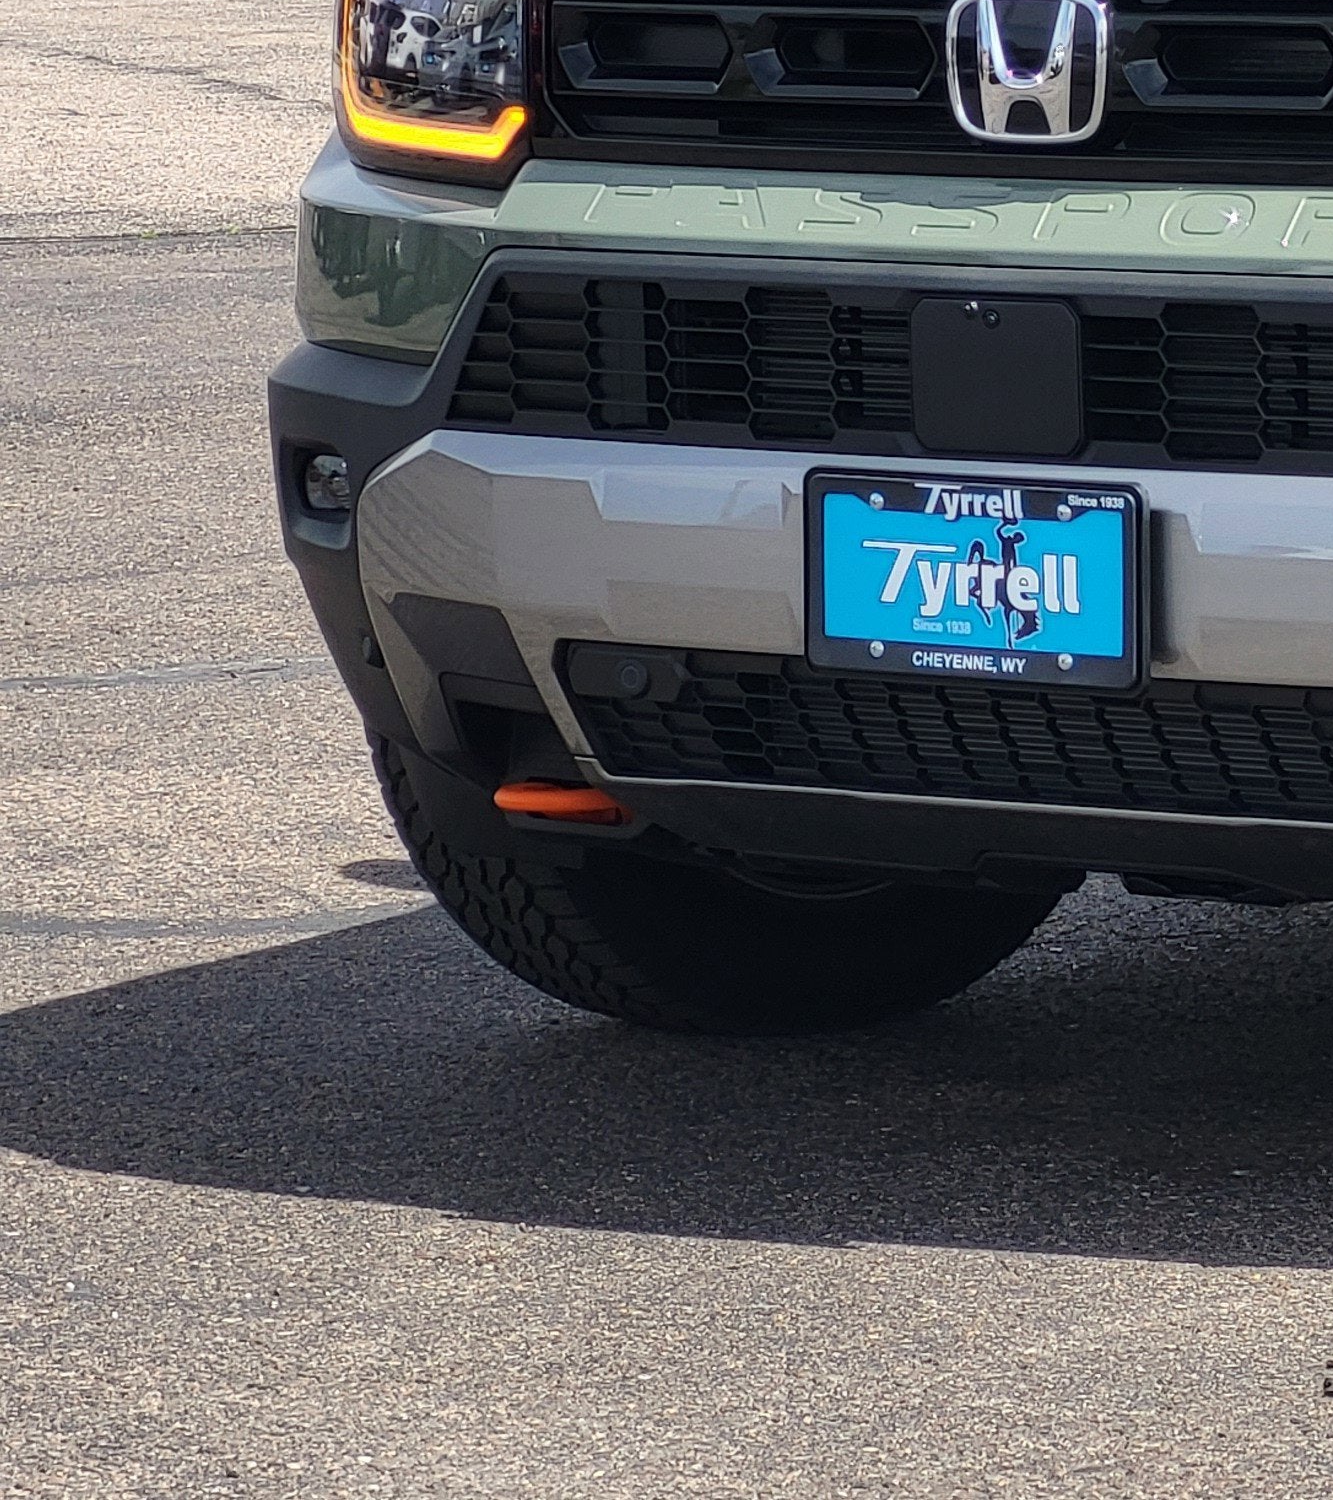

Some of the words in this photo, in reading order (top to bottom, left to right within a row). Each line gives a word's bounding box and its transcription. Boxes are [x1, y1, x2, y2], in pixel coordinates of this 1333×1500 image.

[914, 483, 1024, 521] Tyrrell
[1068, 494, 1097, 508] Since
[1099, 496, 1125, 510] 1938
[862, 539, 1080, 617] Tyrrell
[913, 618, 944, 634] Since
[946, 619, 971, 635] 1938
[912, 650, 997, 674] CHEYENNE,
[1000, 657, 1027, 674] WY
